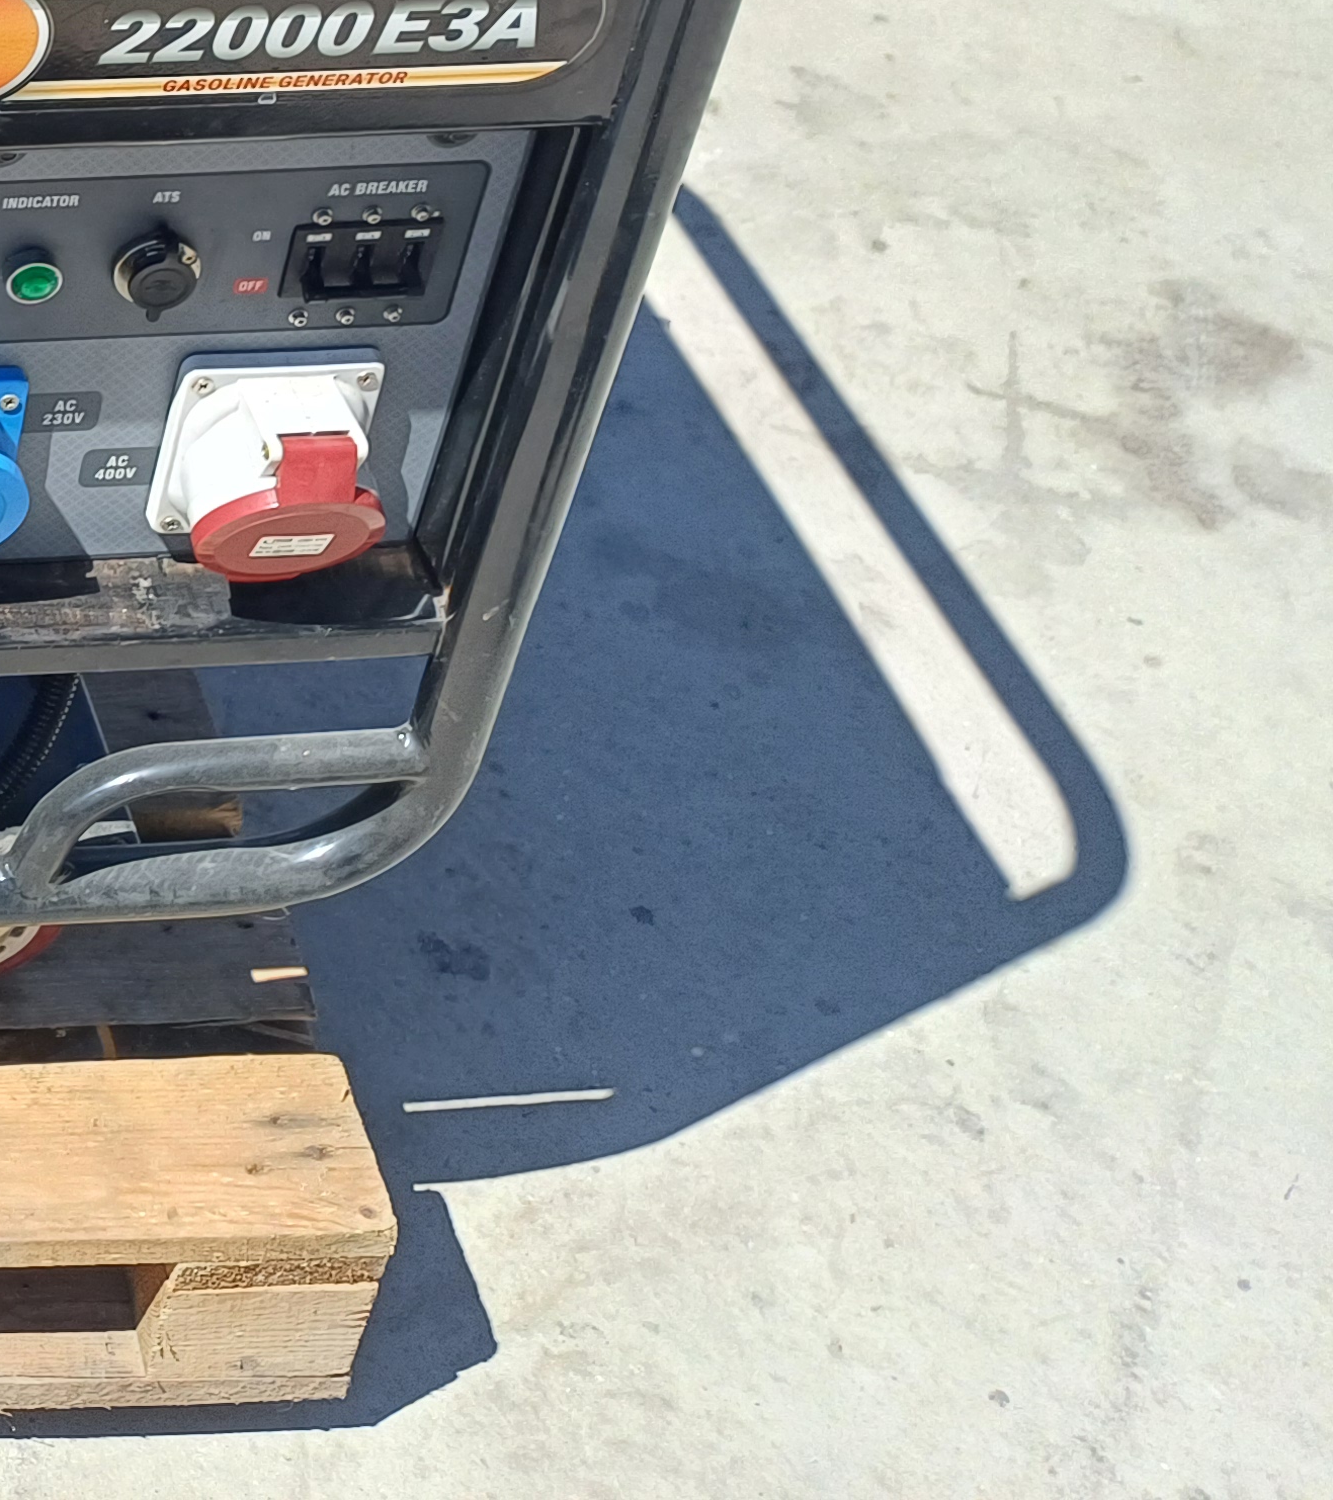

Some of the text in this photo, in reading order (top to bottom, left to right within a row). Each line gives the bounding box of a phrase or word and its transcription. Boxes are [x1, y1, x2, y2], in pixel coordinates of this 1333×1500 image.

[162, 71, 409, 93] GASOLINE GENERATOR
[328, 179, 428, 197] AC BREAKER
[2, 194, 80, 210] INDICATOR
[153, 190, 181, 204] ATS
[252, 230, 271, 242] ON
[238, 280, 265, 292] OFF
[54, 399, 77, 412] AC
[42, 411, 85, 426] 230V
[106, 455, 130, 468] AC
[94, 467, 137, 481] 400V
